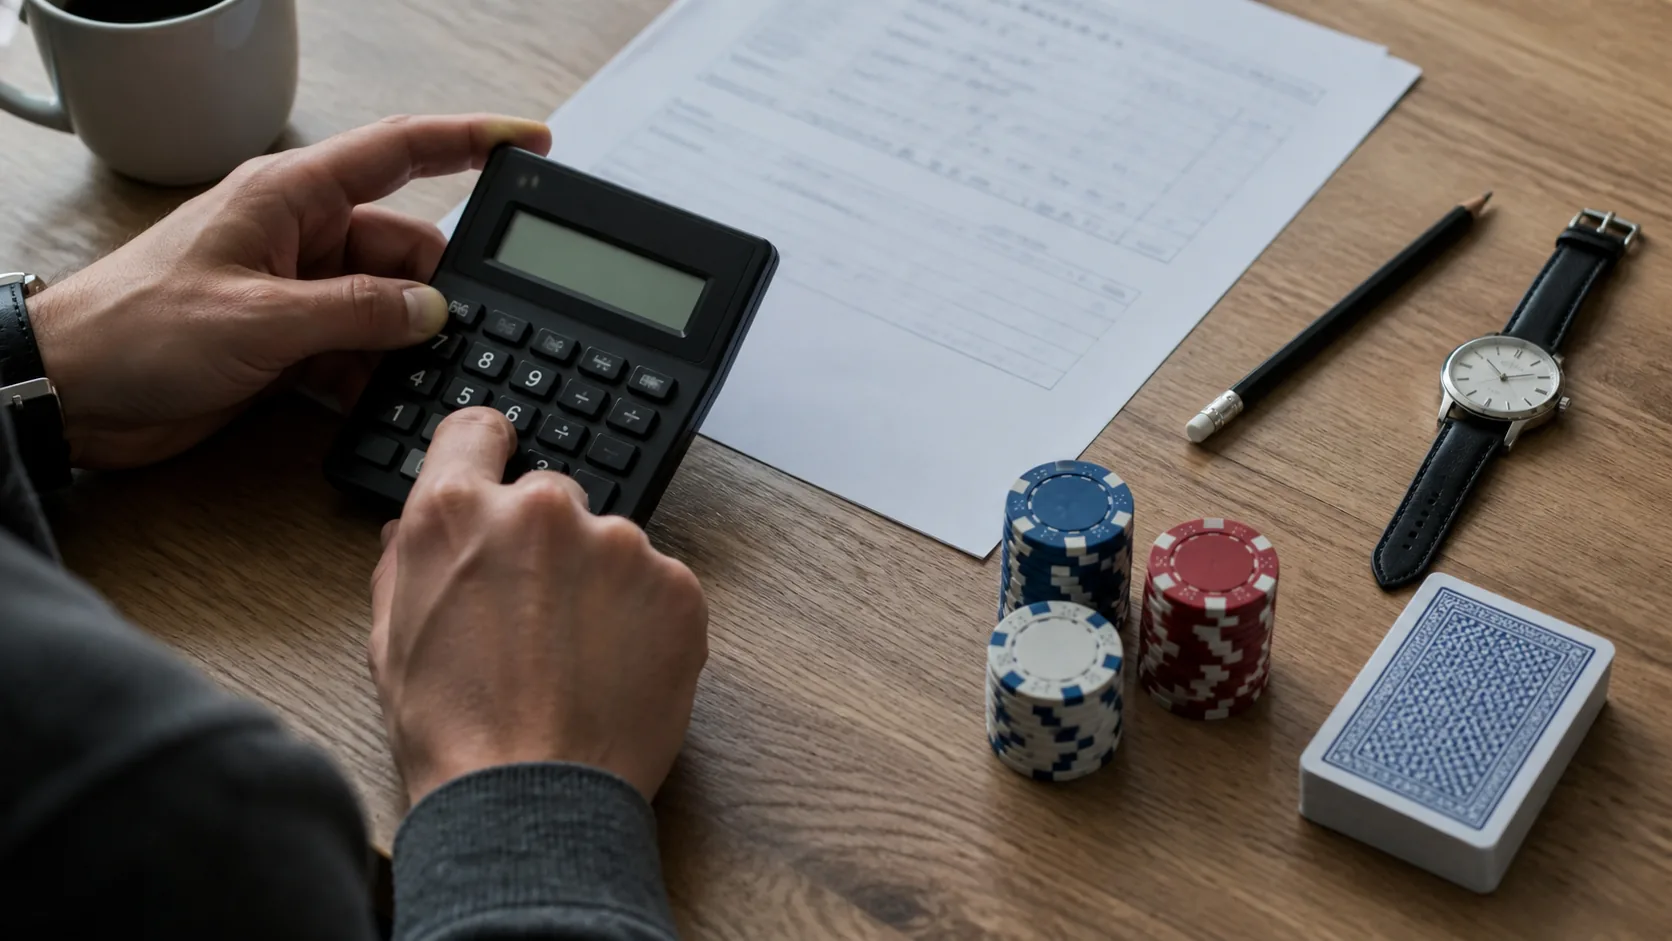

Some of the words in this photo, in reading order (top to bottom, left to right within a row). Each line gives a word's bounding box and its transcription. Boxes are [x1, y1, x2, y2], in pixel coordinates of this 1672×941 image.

[431, 334, 449, 350] 7
[478, 352, 494, 369] 8
[525, 370, 542, 387] 9
[392, 404, 404, 421] 1
[409, 369, 426, 387] 4
[456, 386, 474, 405] 5
[505, 405, 522, 422] 6
